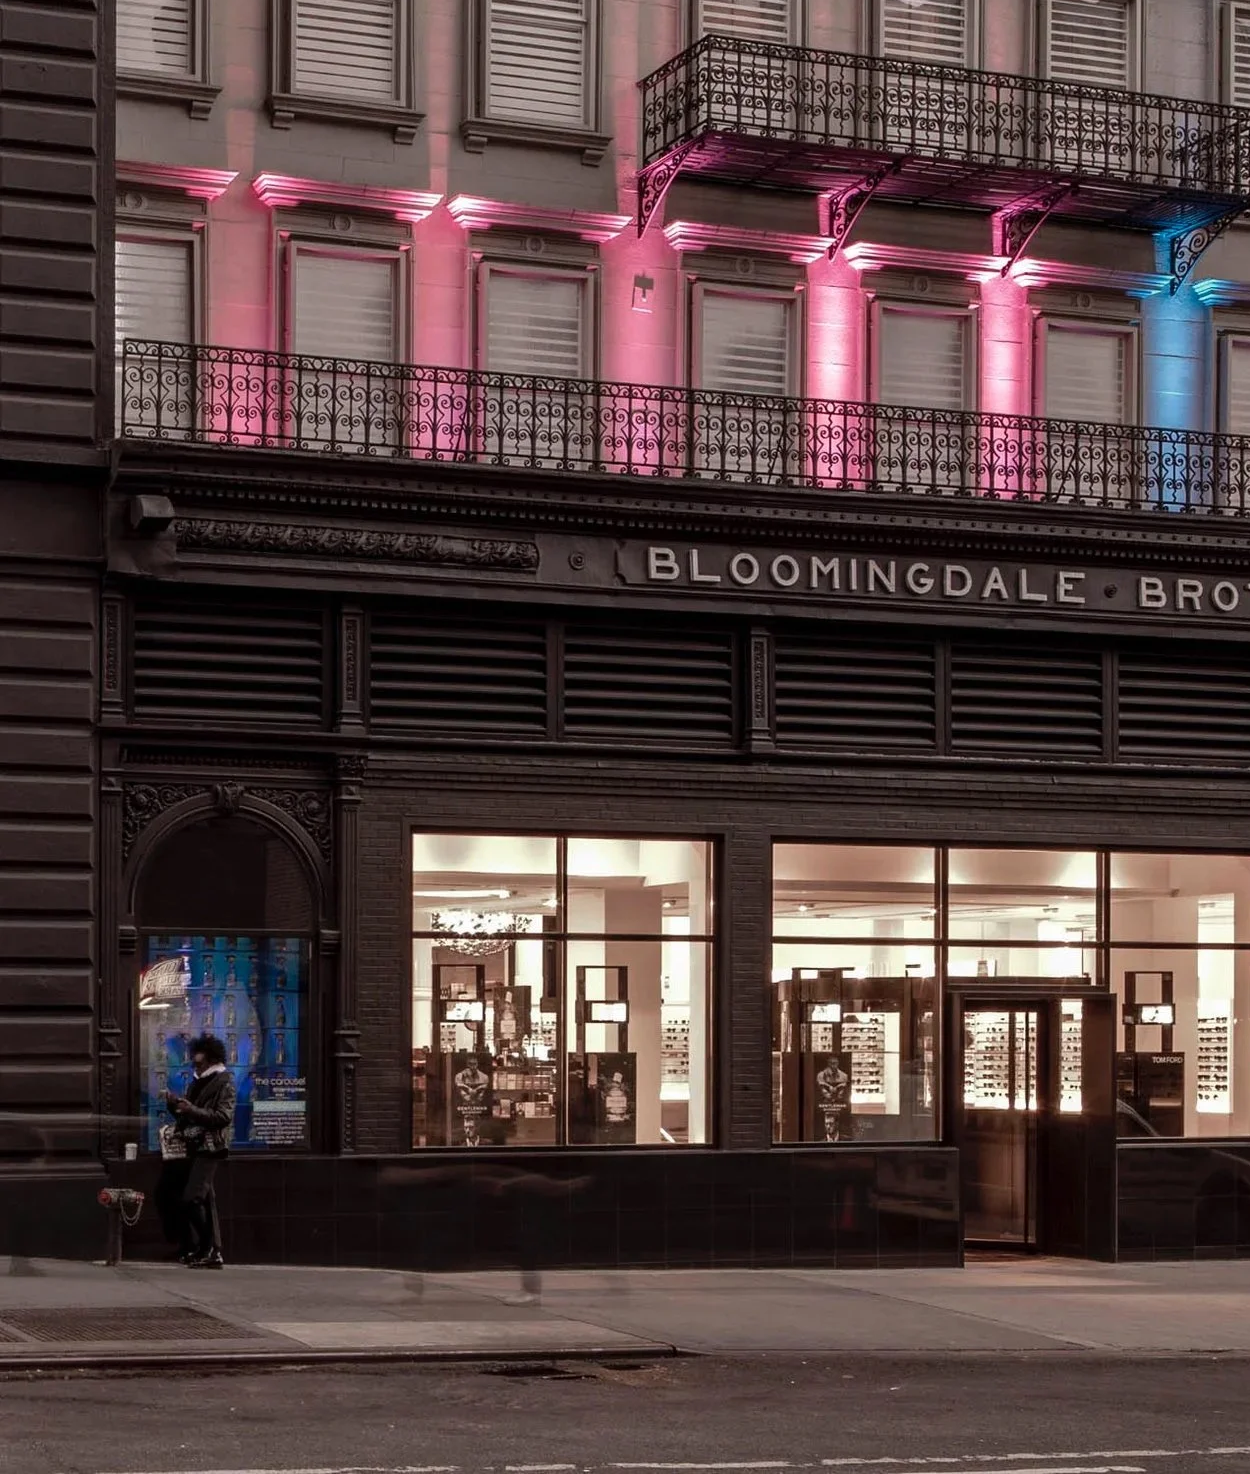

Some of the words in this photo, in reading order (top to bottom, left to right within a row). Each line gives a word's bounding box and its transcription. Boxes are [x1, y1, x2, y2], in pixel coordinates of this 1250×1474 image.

[647, 545, 1087, 605] BLOOMINGDALE
[255, 1077, 268, 1086] the
[270, 1076, 306, 1086] carousel
